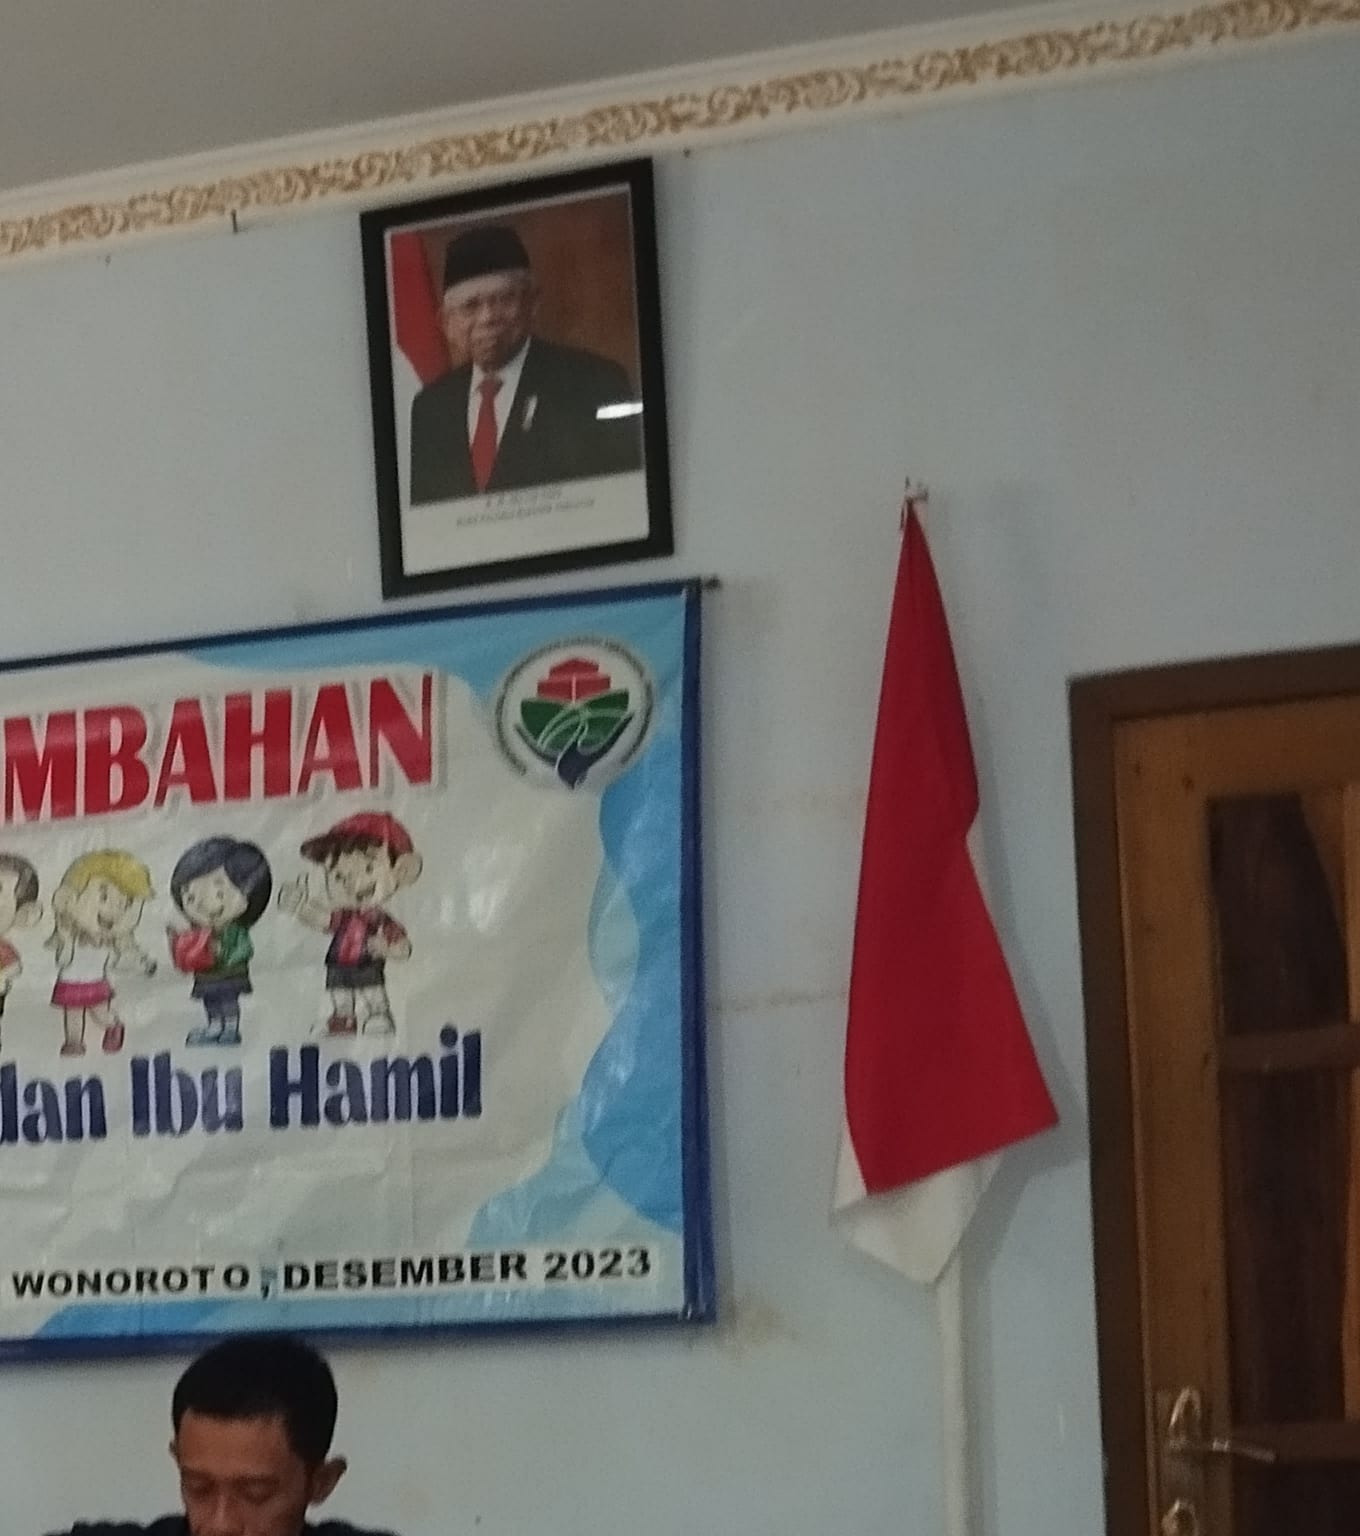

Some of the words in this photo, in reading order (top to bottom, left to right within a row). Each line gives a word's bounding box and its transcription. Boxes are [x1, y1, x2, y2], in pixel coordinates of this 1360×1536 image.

[130, 1049, 244, 1137] Ibu
[269, 1023, 482, 1130] Hamil
[283, 1251, 528, 1292] DESEMBER
[544, 1248, 651, 1281] 2023
